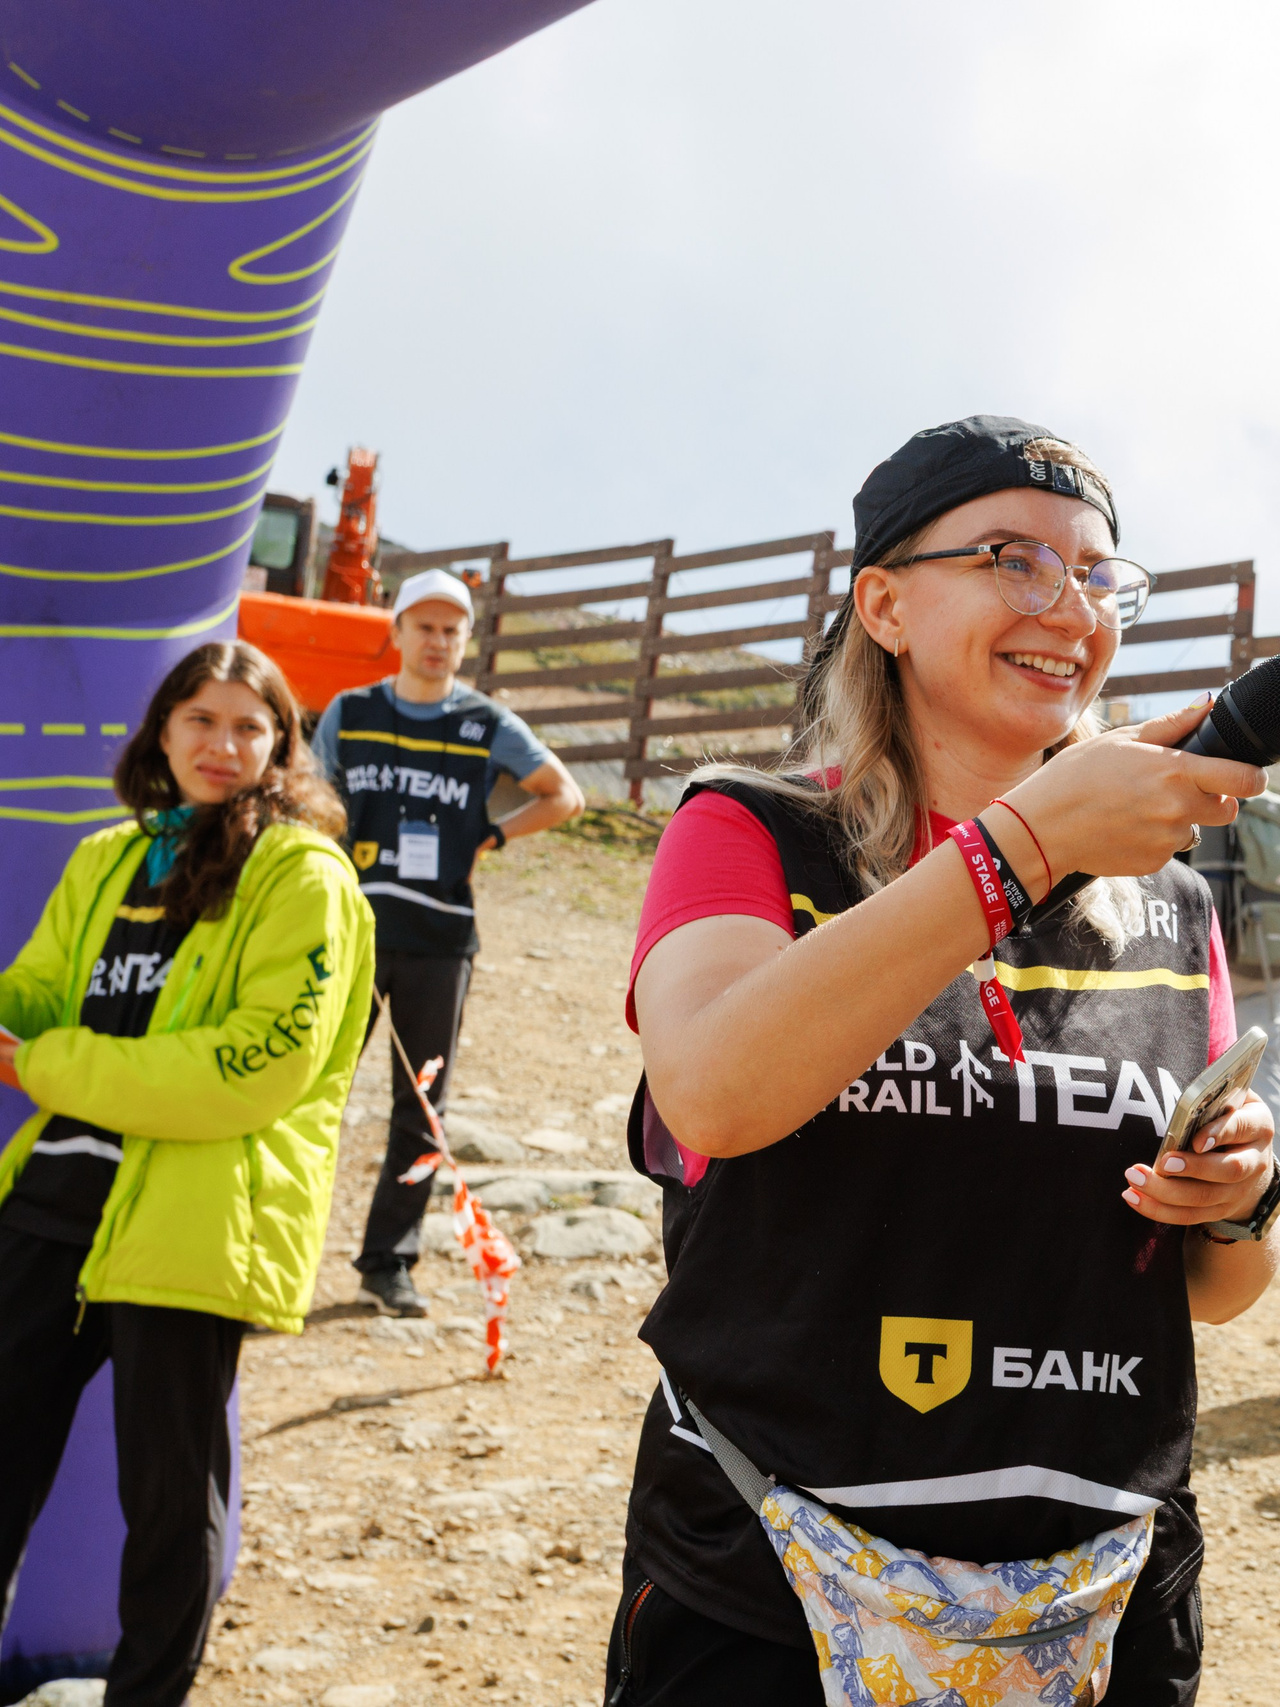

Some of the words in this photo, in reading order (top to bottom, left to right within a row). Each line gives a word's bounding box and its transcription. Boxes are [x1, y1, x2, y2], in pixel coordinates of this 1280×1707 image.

[394, 766, 470, 810] TEAM
[971, 854, 999, 904] STAGE
[822, 1079, 952, 1116] RAIL
[992, 1346, 1143, 1396] БАНК
